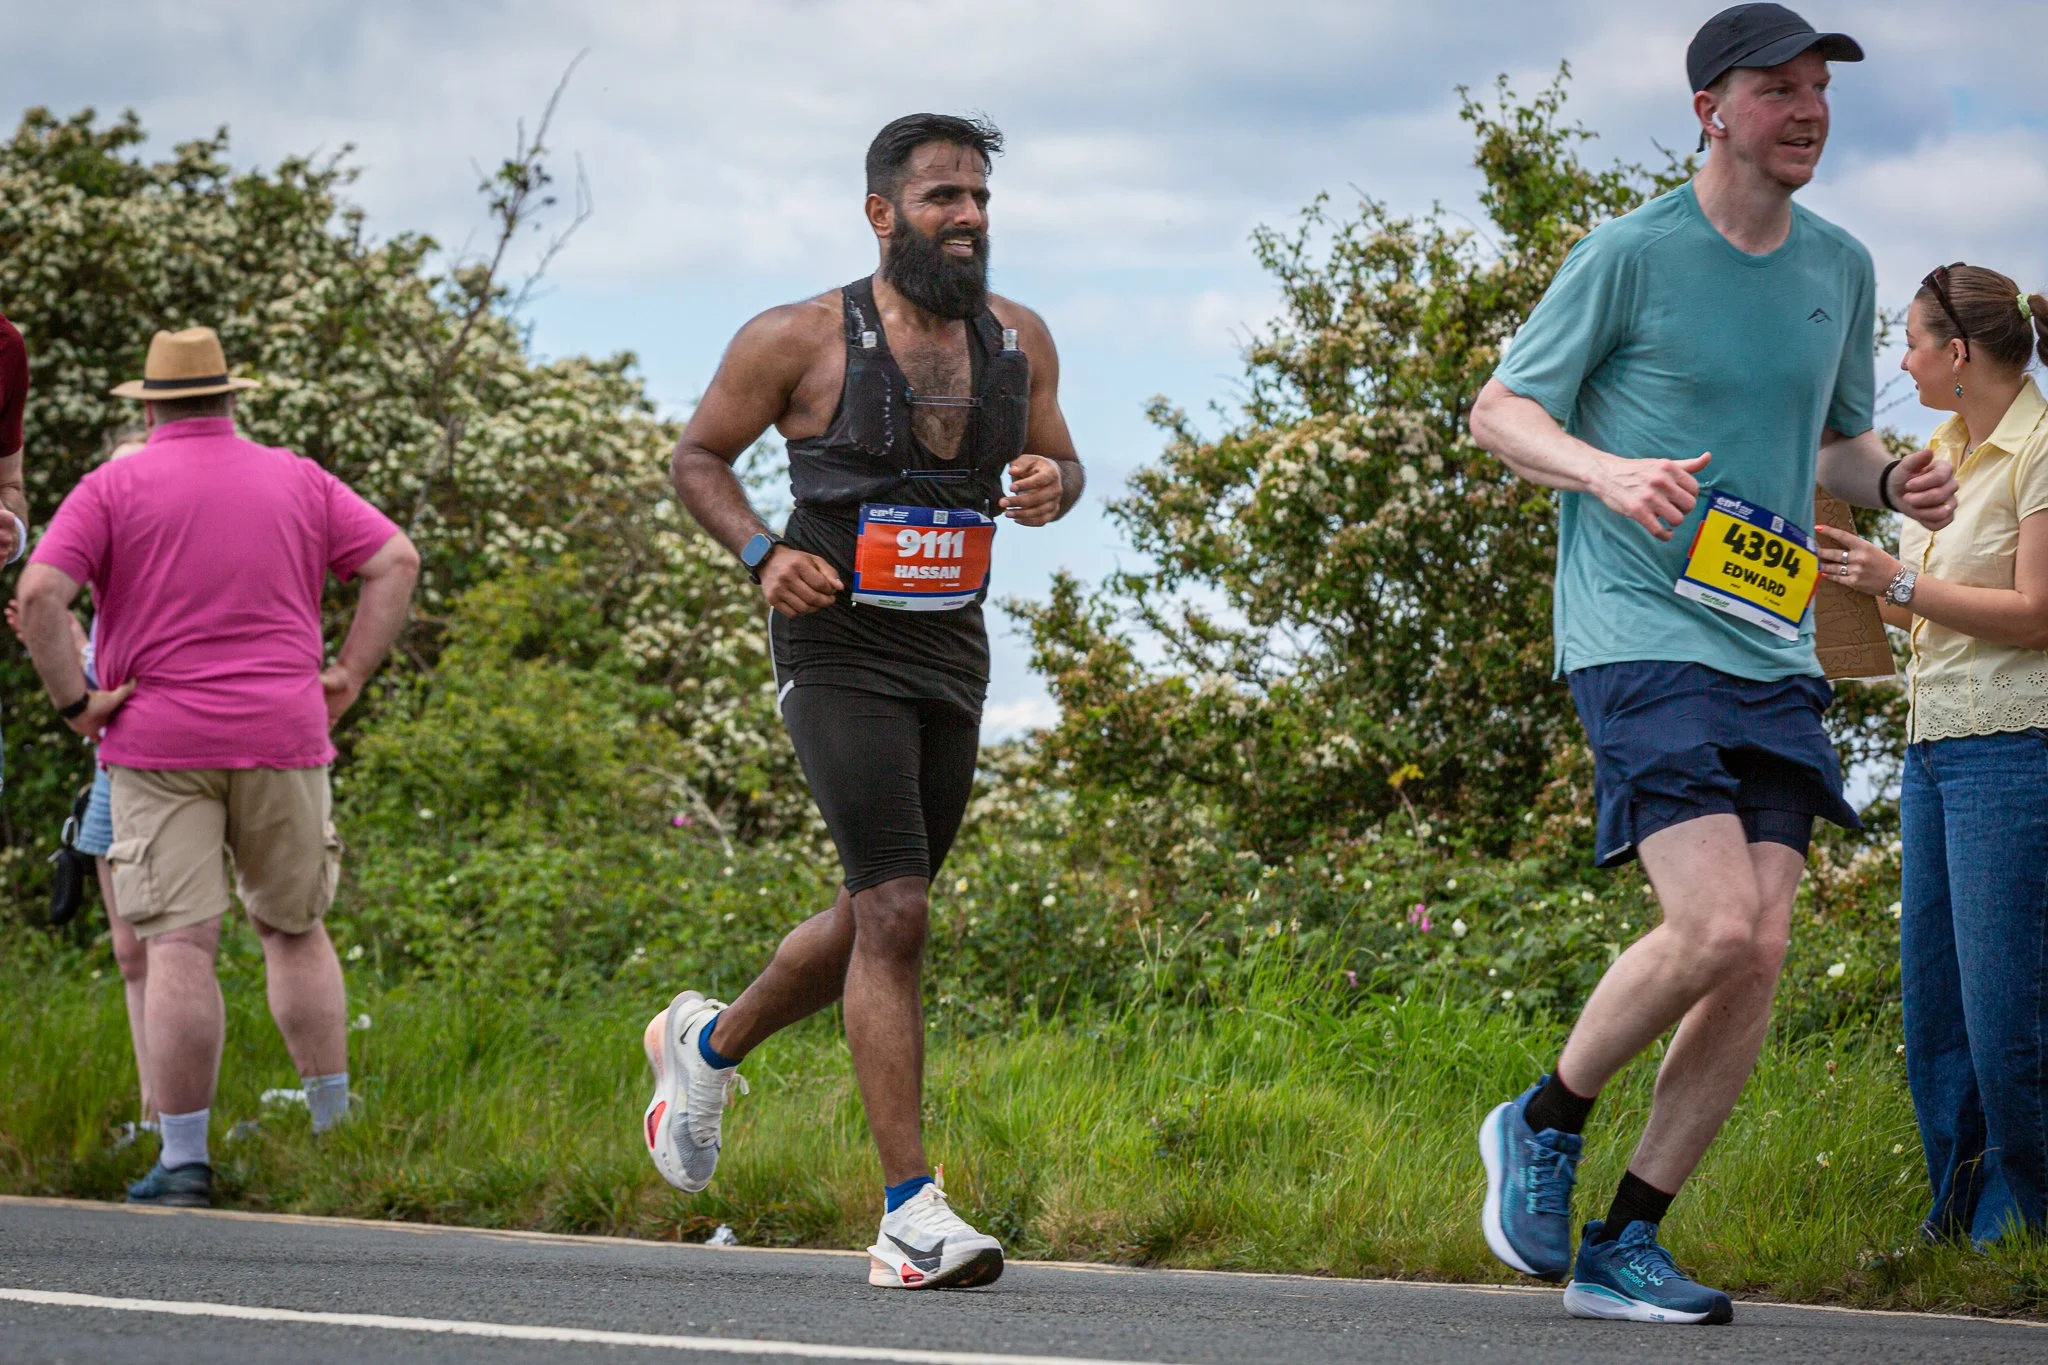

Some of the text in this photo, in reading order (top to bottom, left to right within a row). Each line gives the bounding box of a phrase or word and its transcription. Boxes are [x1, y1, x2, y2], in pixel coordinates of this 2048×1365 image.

[895, 529, 965, 558] 9111
[1722, 522, 1801, 579] 4394
[894, 565, 961, 579] HASSAN
[1721, 561, 1786, 598] EDWARD
[1618, 1266, 1647, 1288] BROOKS
